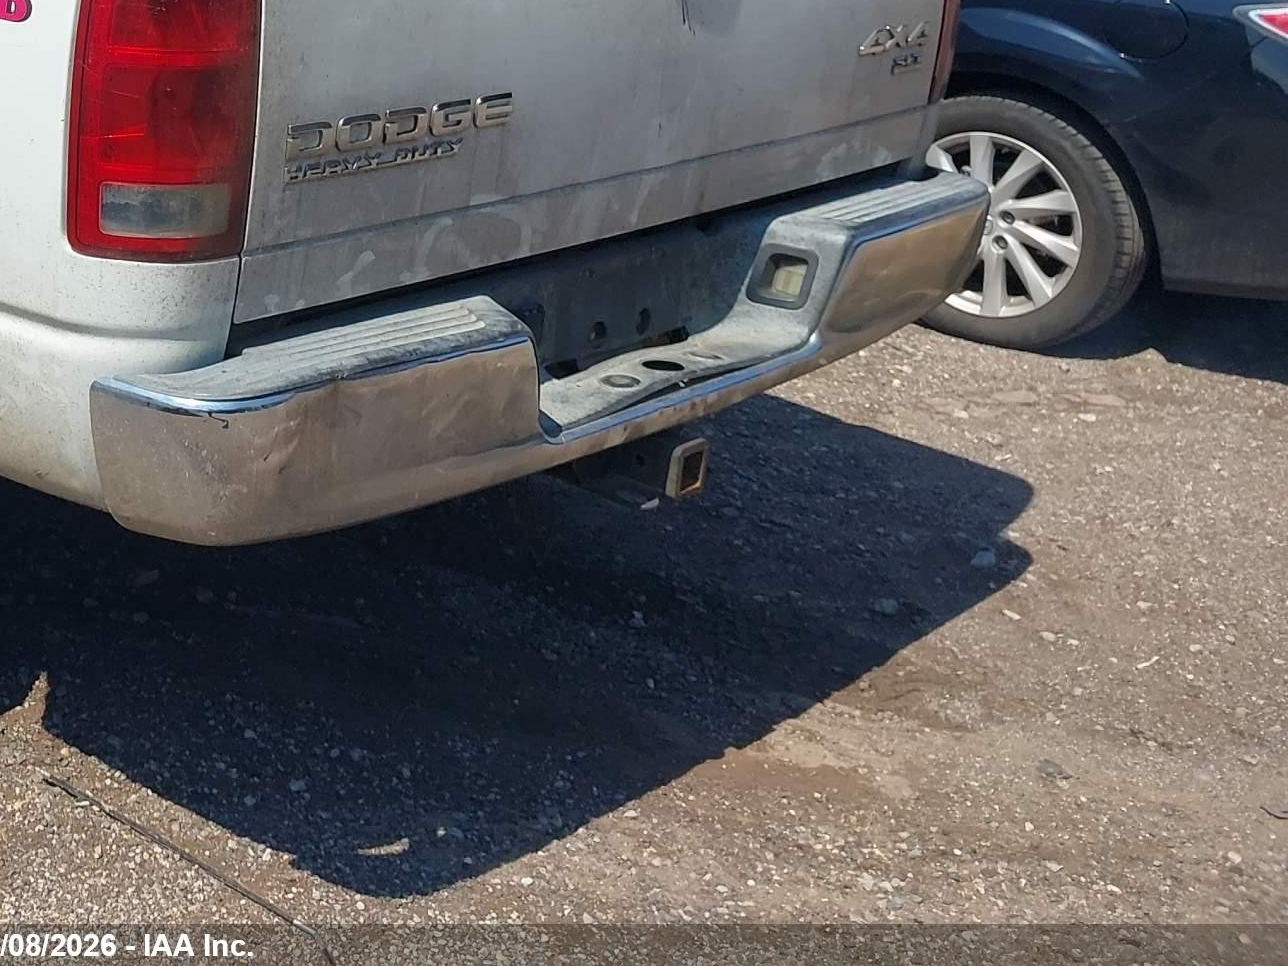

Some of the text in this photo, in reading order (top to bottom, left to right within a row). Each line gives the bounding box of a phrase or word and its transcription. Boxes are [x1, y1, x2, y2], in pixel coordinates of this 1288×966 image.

[285, 91, 513, 161] DODGE
[284, 137, 464, 184] HEAVY DUTY
